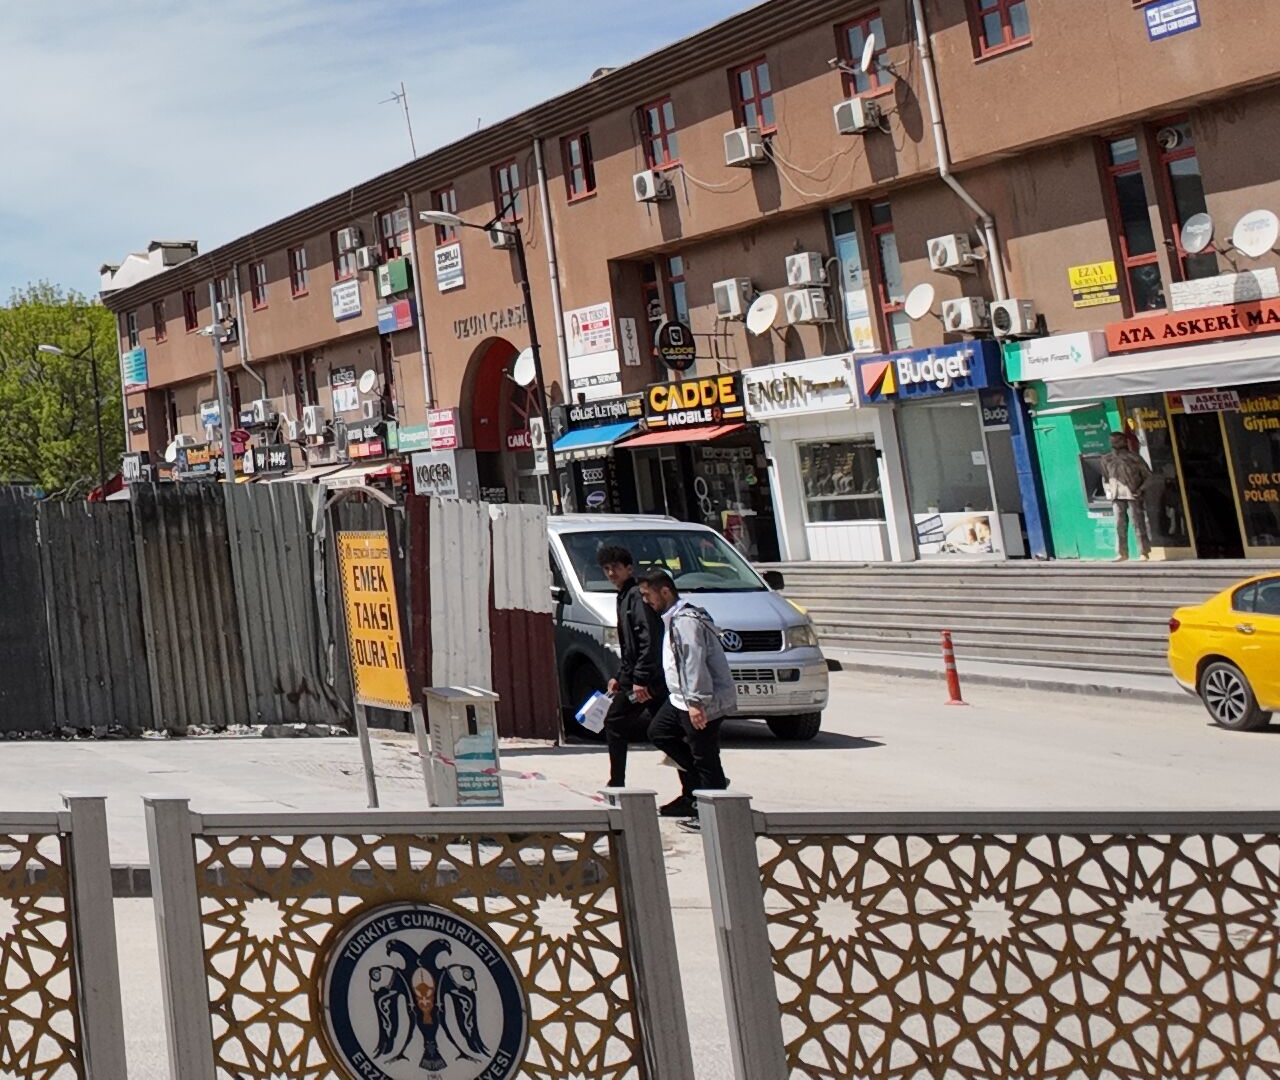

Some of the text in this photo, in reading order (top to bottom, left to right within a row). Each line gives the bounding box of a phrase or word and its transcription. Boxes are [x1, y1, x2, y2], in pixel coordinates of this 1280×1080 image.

[454, 313, 487, 339] UZUN
[1118, 326, 1155, 345] ATA
[1162, 309, 1240, 339] ASKERİ
[662, 346, 695, 355] CADDE
[897, 350, 971, 388] Budget
[650, 376, 736, 411] CADDE
[747, 372, 807, 405] ENGİN
[1195, 391, 1233, 404] ASKERİ
[1190, 401, 1239, 412] MALZEME
[1244, 416, 1280, 432] Giyim
[507, 434, 524, 448] CAN
[1245, 491, 1278, 502] POLAR
[352, 565, 388, 593] EMEK
[354, 599, 394, 631] TAKSİ
[755, 684, 774, 695] 531
[344, 914, 500, 967] TÜRKİYE CUMHURİYETİ
